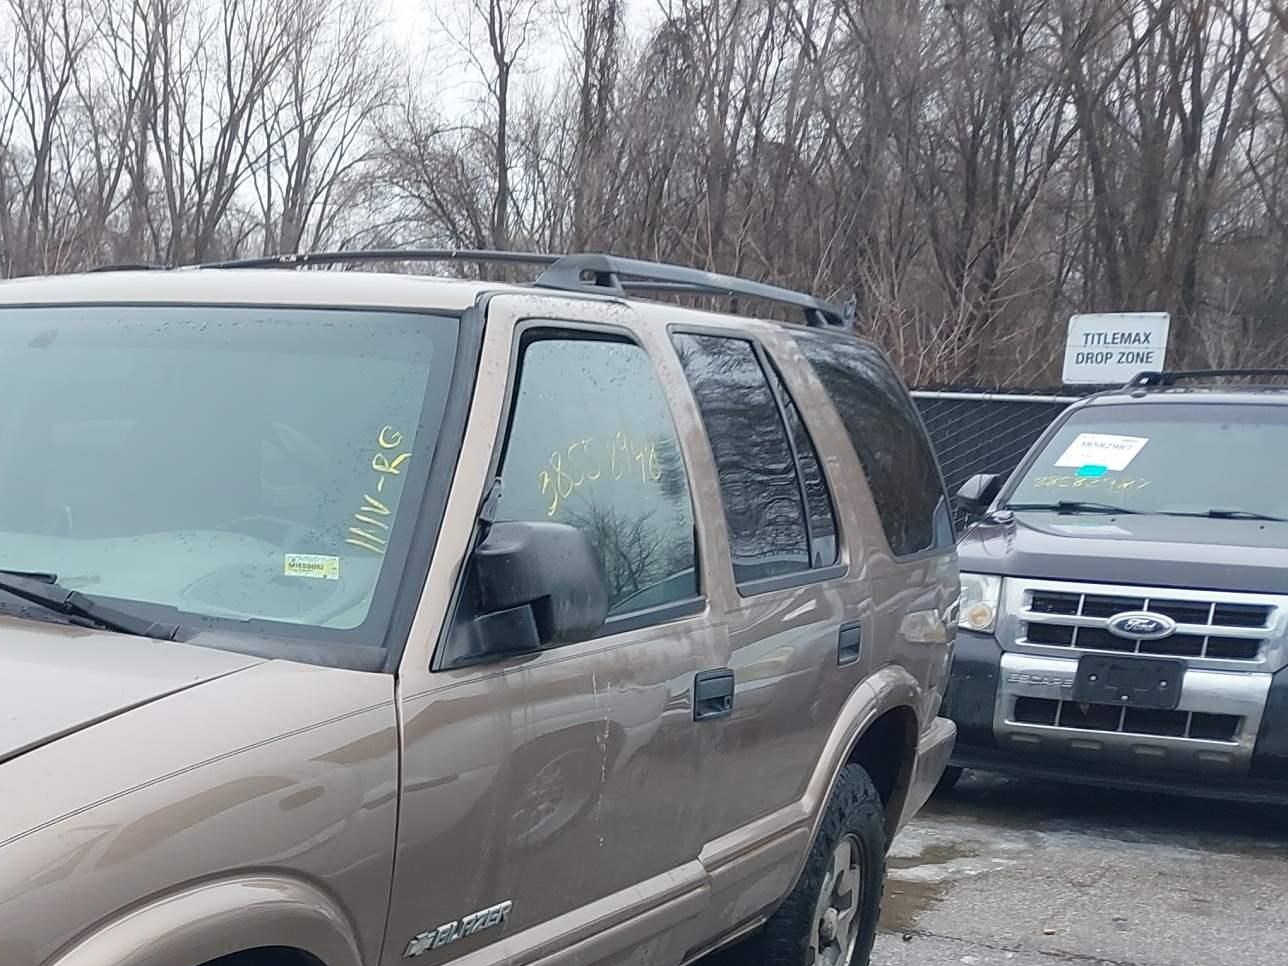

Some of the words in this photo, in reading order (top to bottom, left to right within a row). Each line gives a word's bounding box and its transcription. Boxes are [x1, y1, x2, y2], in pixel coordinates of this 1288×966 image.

[1083, 331, 1152, 345] TITLEMAX
[1075, 351, 1113, 365] DROP
[1116, 351, 1154, 365] ZONE
[1123, 617, 1155, 632] Ford
[1008, 672, 1074, 688] ESCAPE
[432, 900, 512, 949] BLAZER
